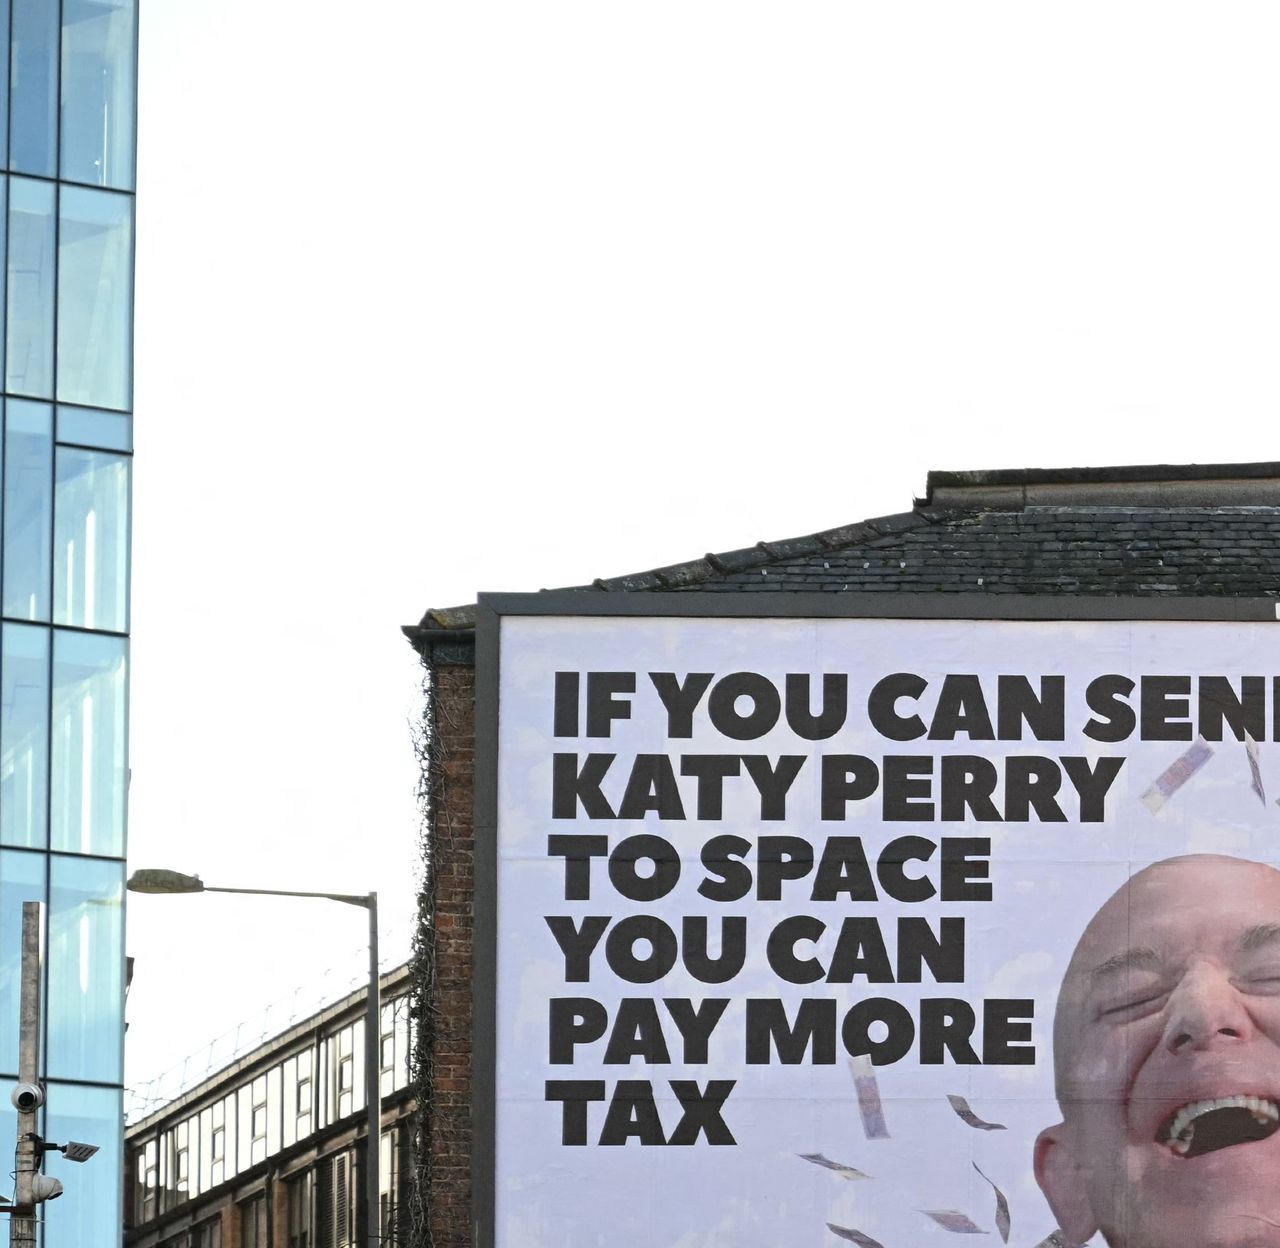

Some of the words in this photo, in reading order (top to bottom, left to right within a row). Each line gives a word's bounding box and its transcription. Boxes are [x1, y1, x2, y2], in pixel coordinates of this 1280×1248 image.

[554, 671, 636, 738] IF
[648, 671, 848, 741] YOU
[867, 672, 1065, 742] CAN
[552, 752, 808, 821] KATY
[821, 754, 1126, 823] PERRY
[547, 834, 681, 902] TO
[697, 834, 993, 903] SPACE
[543, 914, 747, 984] YOU
[766, 915, 965, 985] CAN
[549, 997, 731, 1065] PAY
[745, 997, 1036, 1067] MORE
[544, 1079, 738, 1146] TAX
